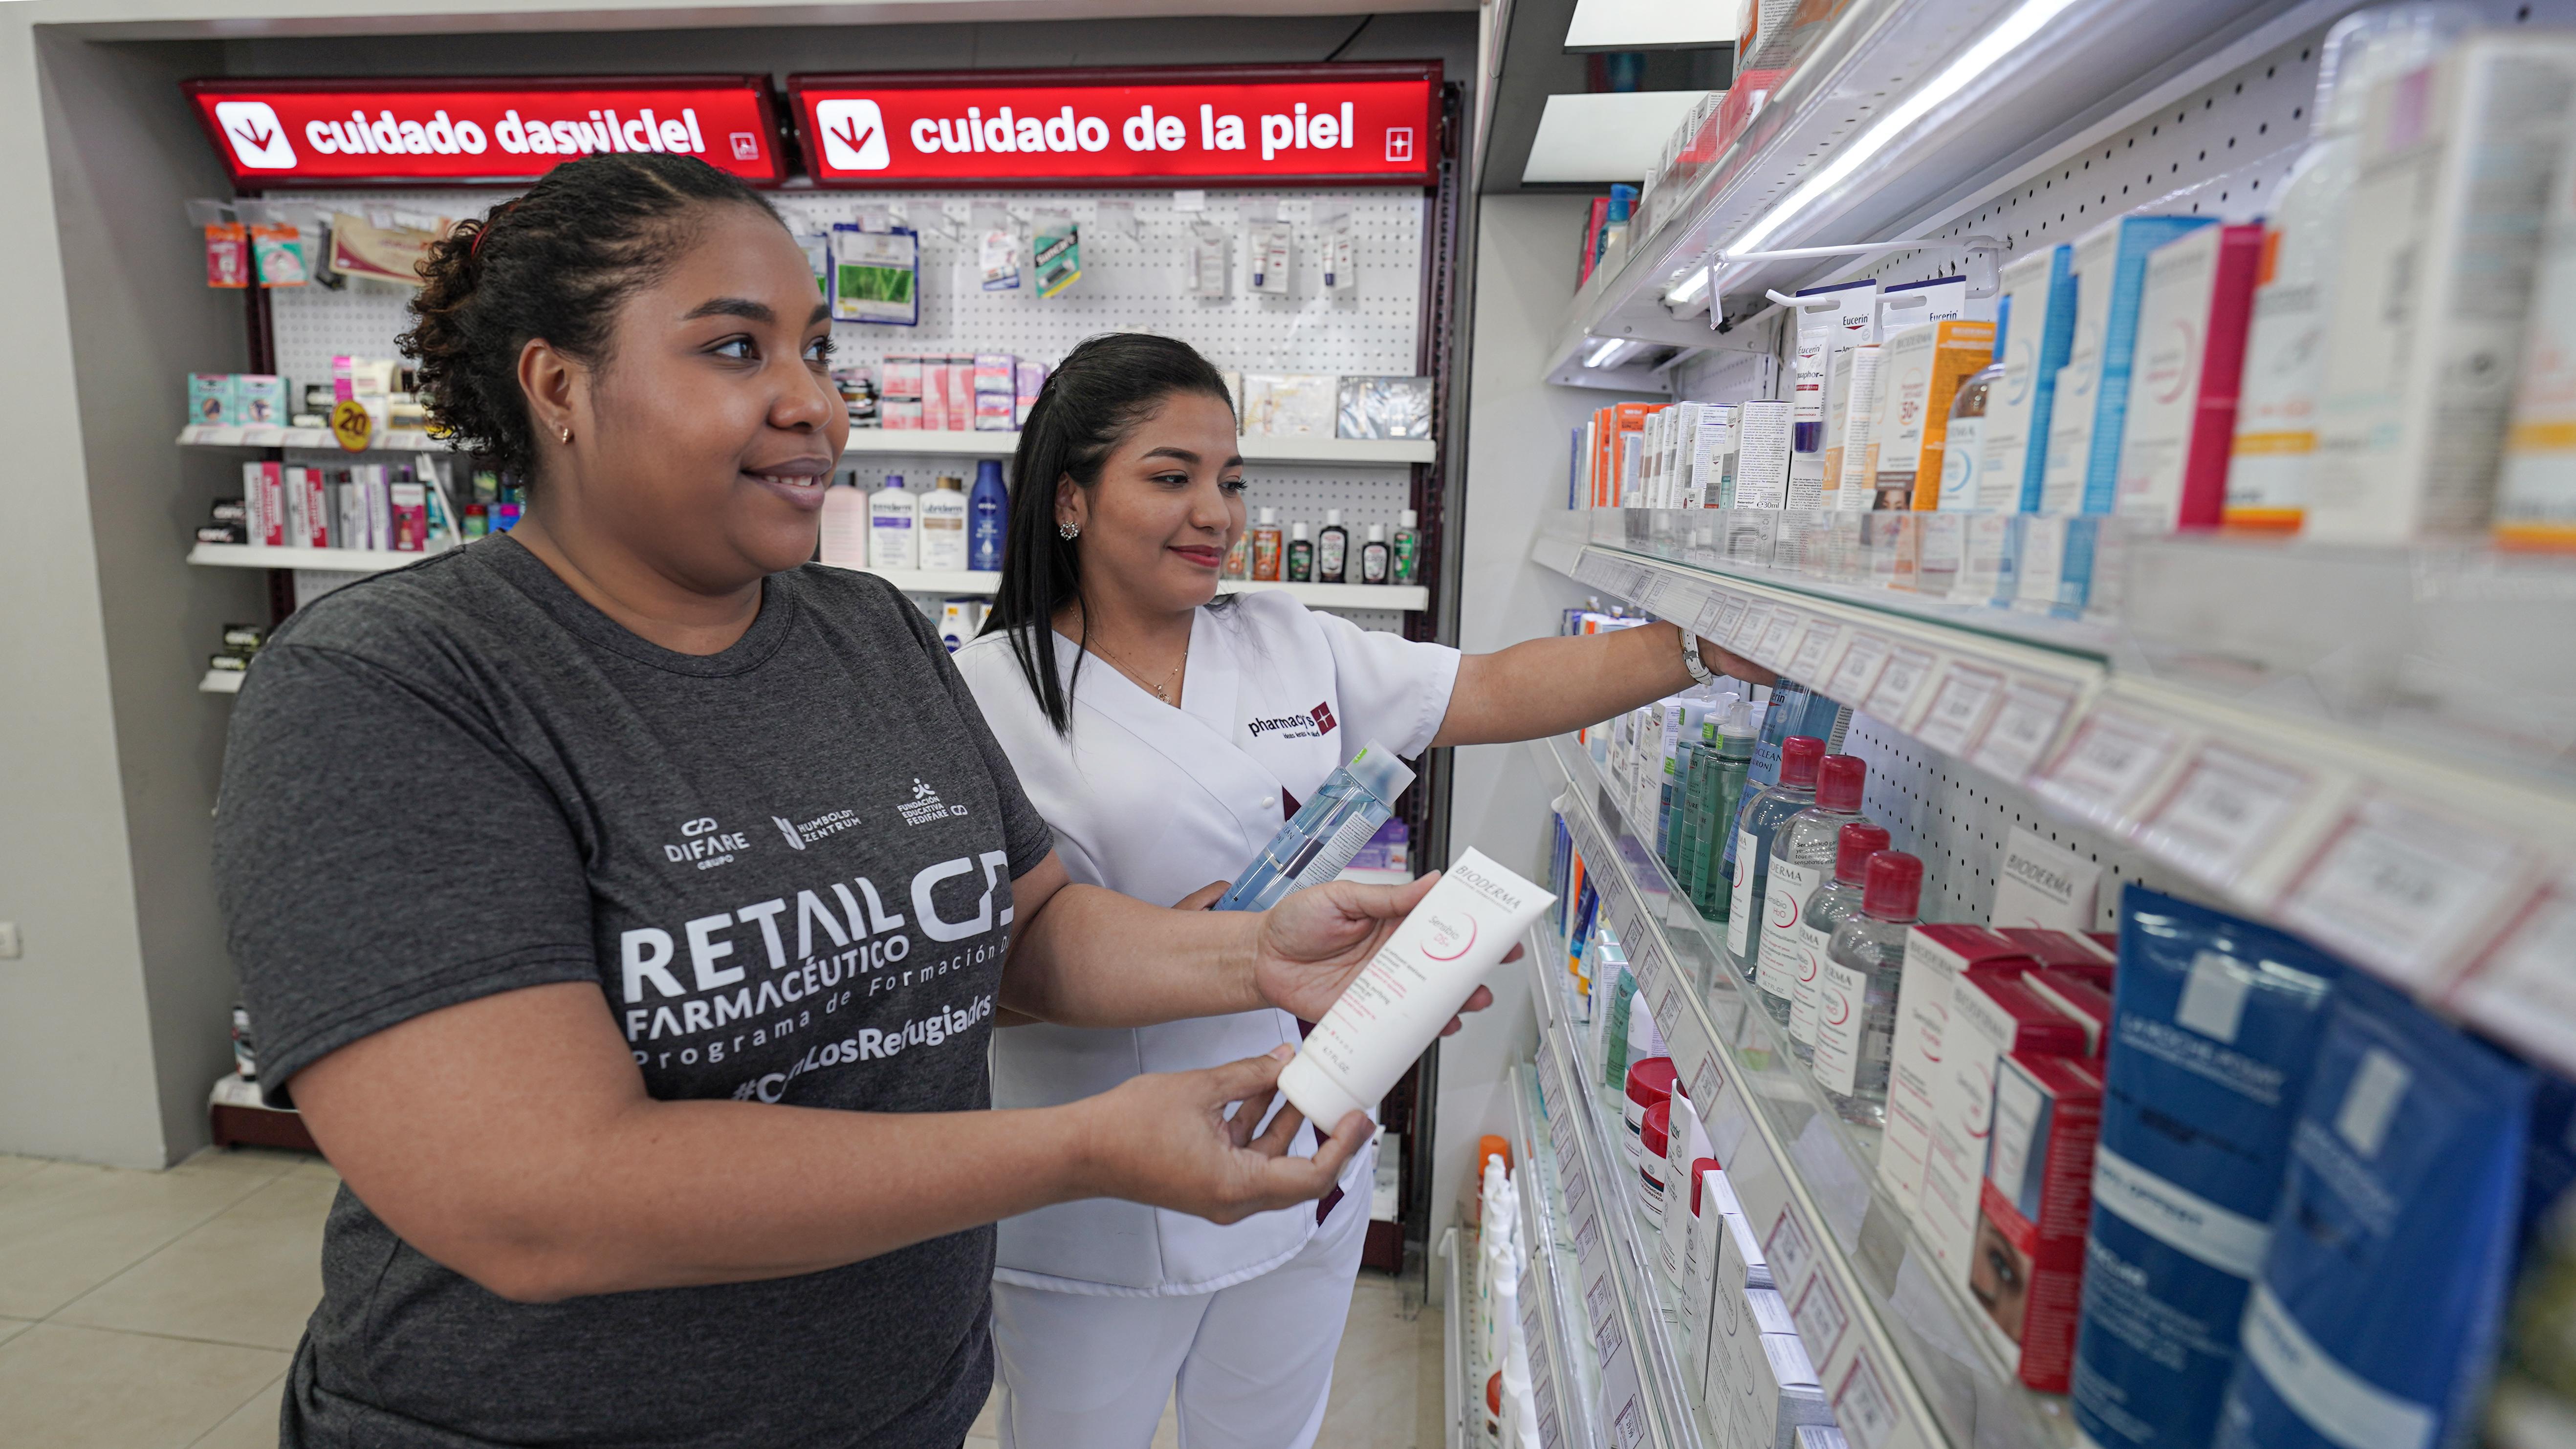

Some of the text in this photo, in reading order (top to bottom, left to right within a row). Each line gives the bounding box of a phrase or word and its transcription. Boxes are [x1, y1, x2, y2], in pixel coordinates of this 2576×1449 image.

[305, 109, 488, 155] cuidado
[910, 102, 1353, 161] cuidado de la piel
[1842, 313, 1869, 326] Eucerin
[1798, 344, 1822, 354] Eucerin
[339, 407, 368, 435] 20
[896, 795, 941, 813] FUNDACIÓN
[901, 803, 946, 819] EDUCATIVA
[797, 809, 855, 834] HUMBOLDT
[802, 818, 862, 843] ZENTRUM
[906, 809, 950, 827] FEDIFARE
[663, 831, 751, 863] DIFARE
[697, 854, 735, 870] GRUPO
[1455, 865, 1521, 909] BIODERMA
[620, 877, 906, 1004] RETAIL
[1428, 914, 1460, 941] Sensibio
[626, 935, 910, 1042] FARMACÉUTICO
[634, 1006, 809, 1069] Programa
[826, 990, 851, 1014] de
[869, 944, 995, 997] Formación
